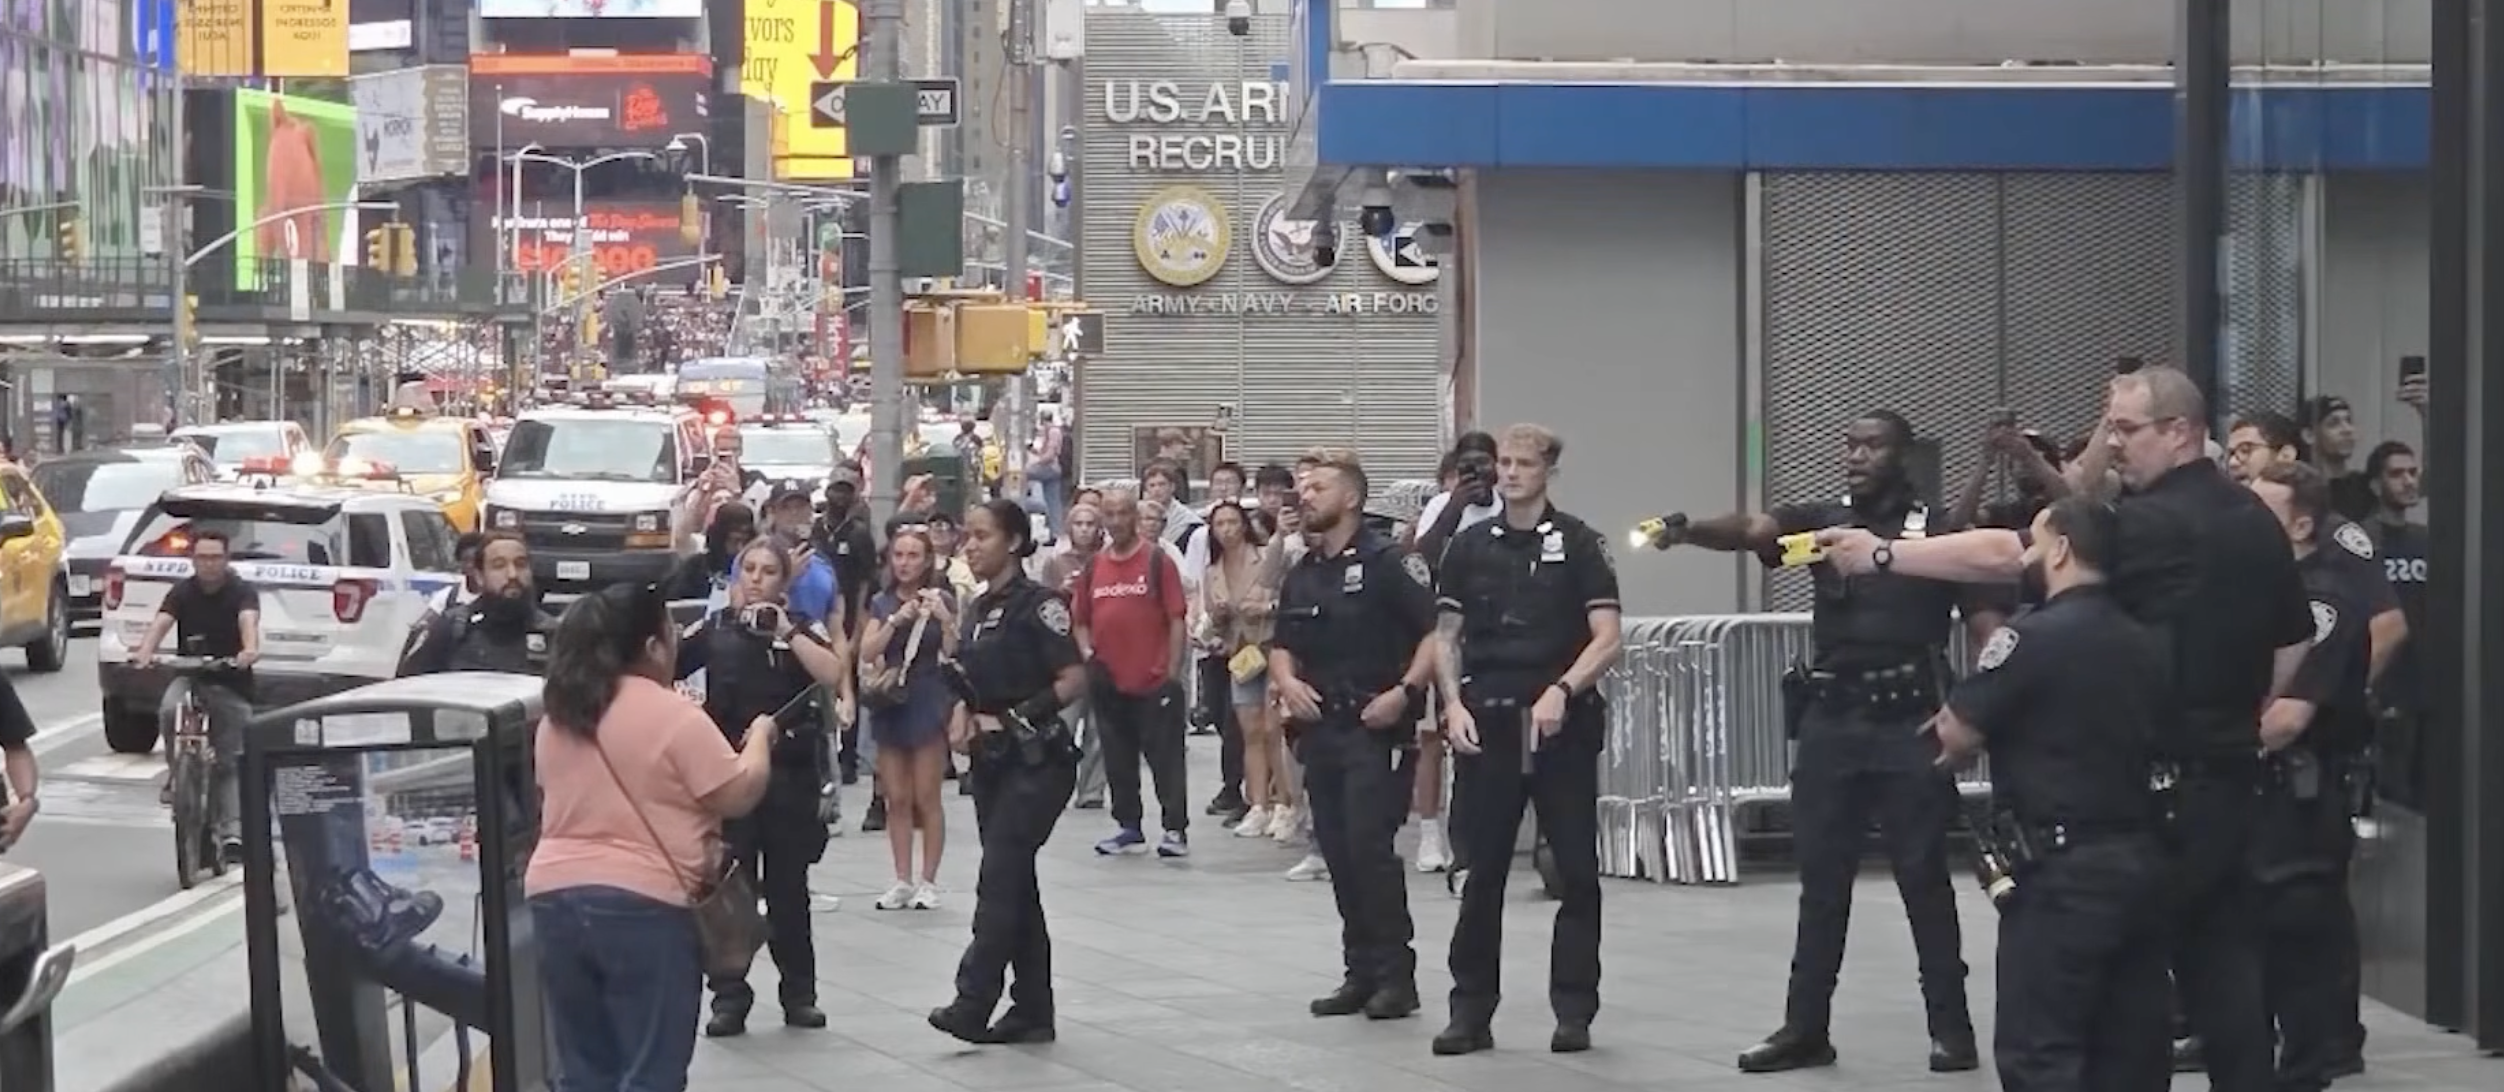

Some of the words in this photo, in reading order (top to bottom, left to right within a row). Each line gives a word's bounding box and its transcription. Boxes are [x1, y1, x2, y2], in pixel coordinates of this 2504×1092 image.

[744, 16, 795, 43] vors
[918, 93, 944, 111] AY
[1105, 80, 1188, 123] U.S.
[1132, 294, 1201, 314] ARMY
[1221, 293, 1293, 313] NAVY
[1324, 293, 1362, 313] AIR
[254, 565, 322, 580] POLICE
